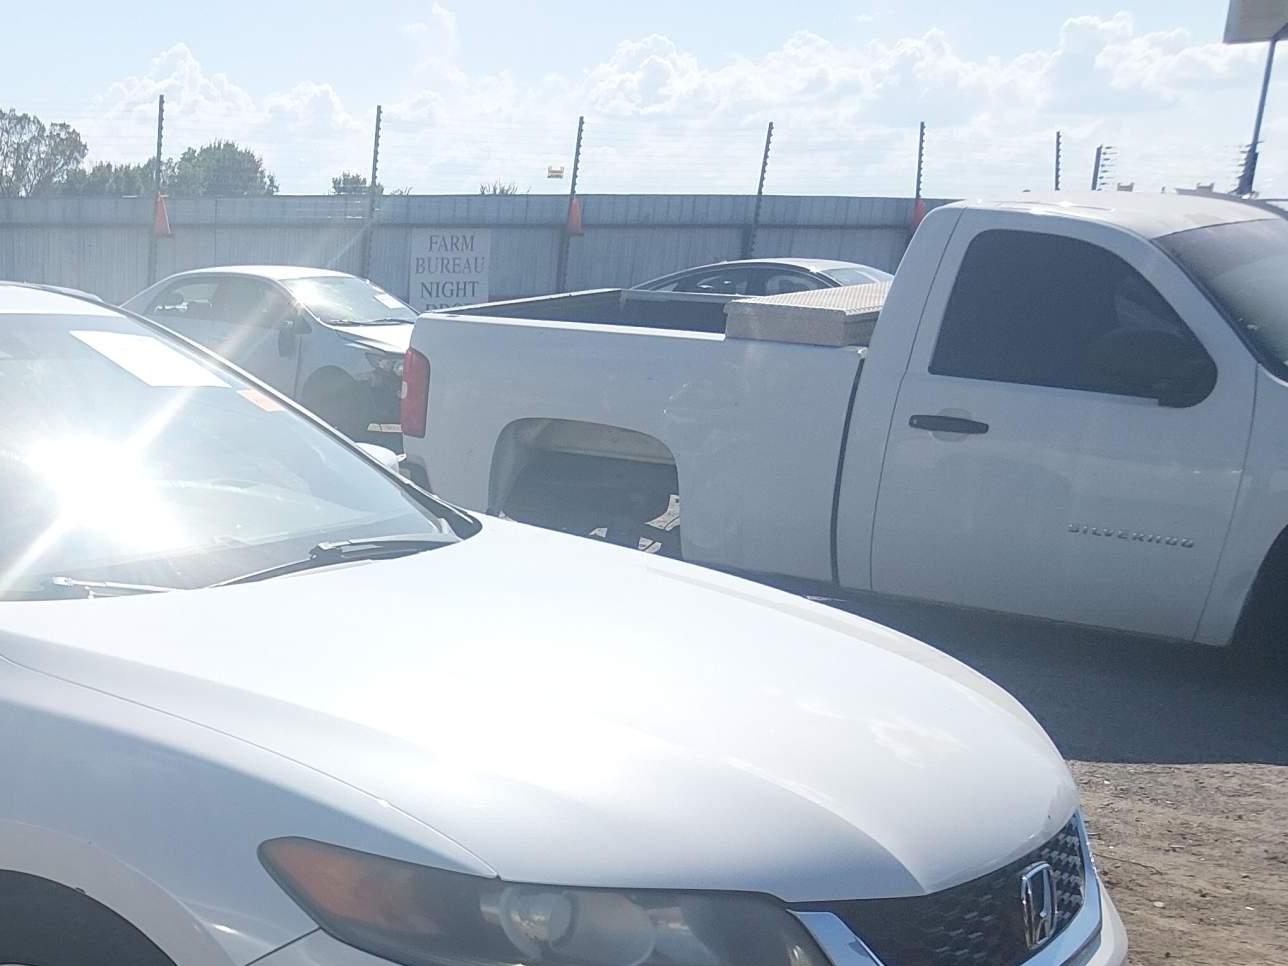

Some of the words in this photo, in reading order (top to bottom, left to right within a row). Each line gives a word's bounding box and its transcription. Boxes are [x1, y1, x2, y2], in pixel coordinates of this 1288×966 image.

[429, 235, 474, 251] FARM
[415, 256, 485, 274] BUREAU
[420, 281, 479, 297] NIGHT
